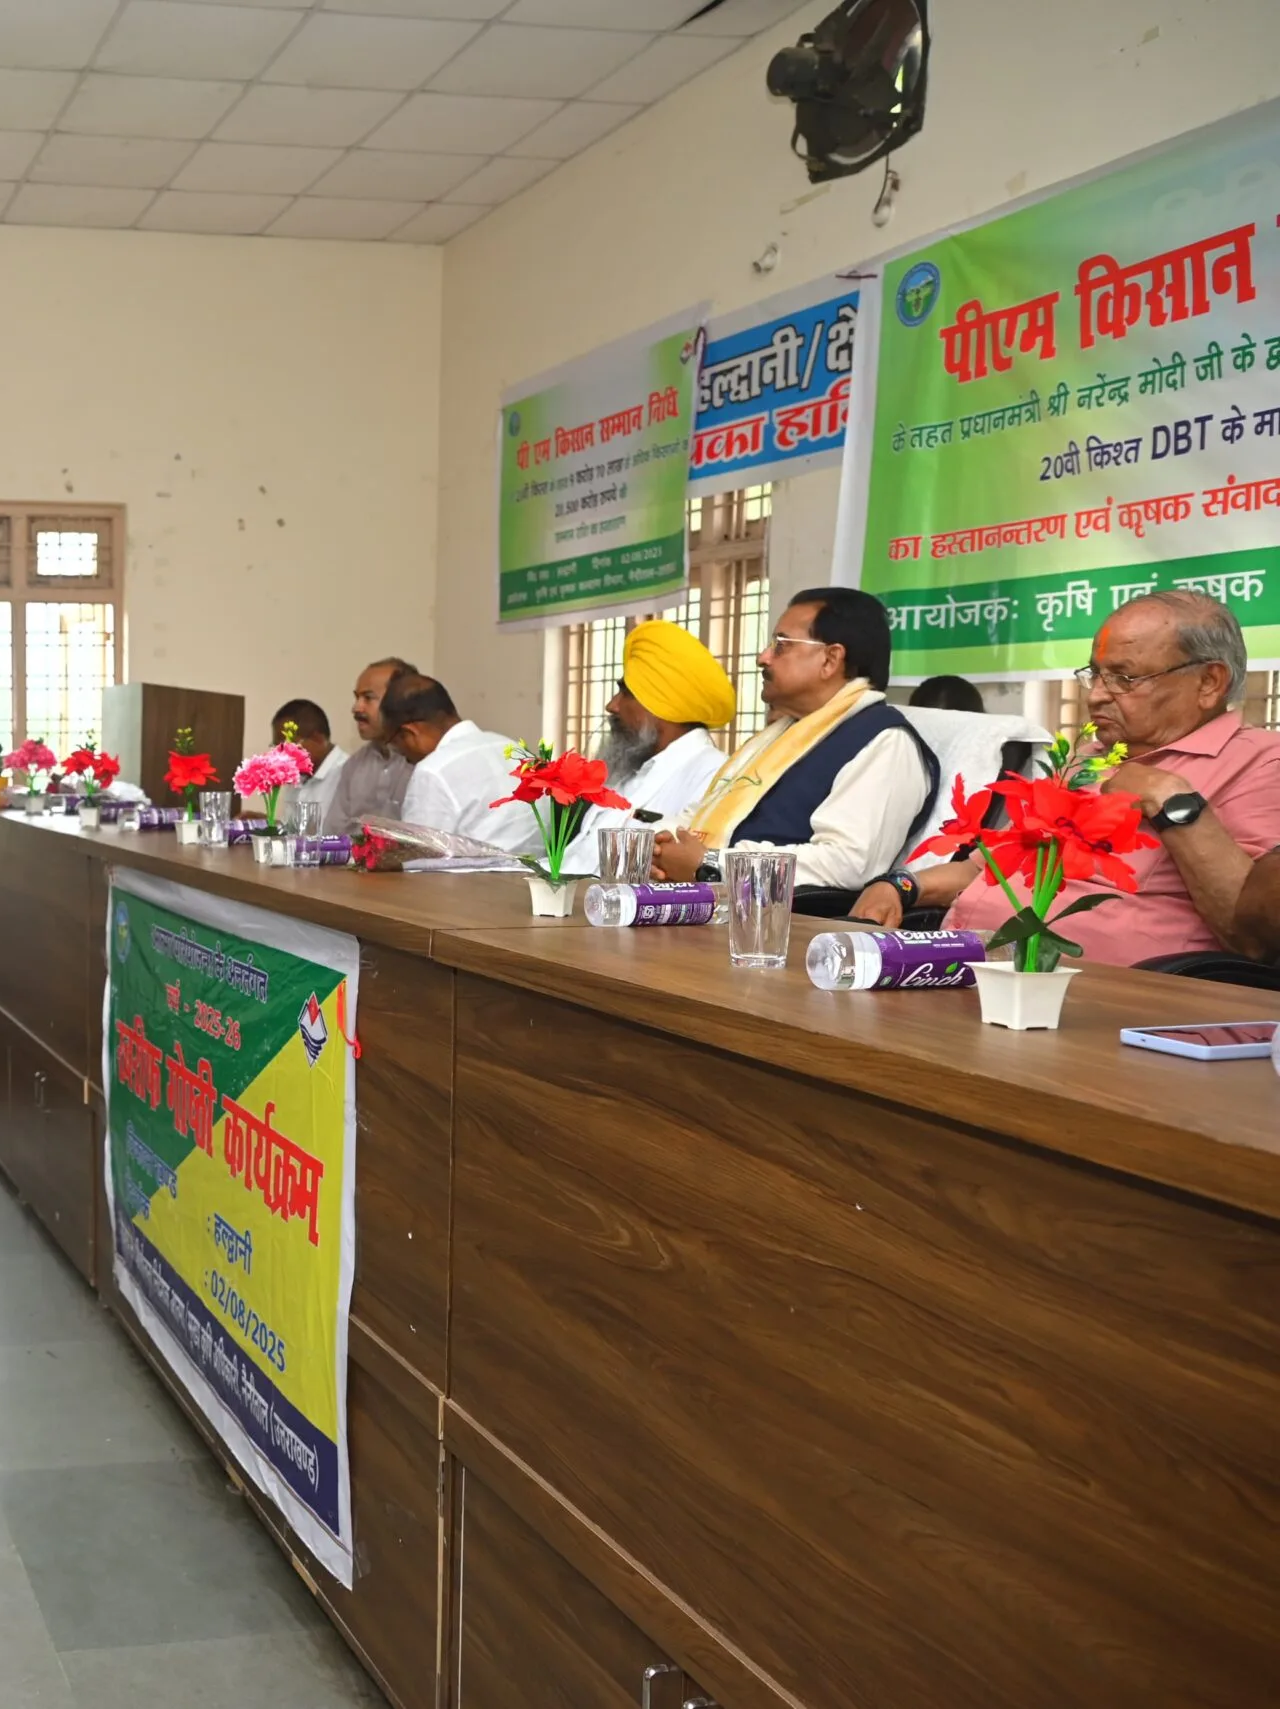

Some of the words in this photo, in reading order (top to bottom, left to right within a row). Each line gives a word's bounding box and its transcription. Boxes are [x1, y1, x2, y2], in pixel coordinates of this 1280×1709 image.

[940, 291, 1060, 383] पीएम
[1074, 222, 1256, 349] किसान
[533, 437, 551, 465] एम
[554, 420, 595, 461] किसान
[599, 404, 644, 443] सम्मान
[892, 422, 906, 453] के
[910, 421, 953, 450] तहत
[960, 390, 1041, 439] प्रधानमंत्री
[1047, 381, 1070, 417] श्री
[1137, 351, 1186, 395] मोदी
[1193, 341, 1224, 381] जी
[1231, 332, 1257, 373] के
[1086, 435, 1143, 472] किश्त
[1151, 414, 1214, 461] DBT
[1221, 404, 1246, 445] के
[888, 536, 923, 561] का
[1074, 496, 1113, 540] एवं
[1118, 492, 1195, 538] कृषक
[1202, 474, 1280, 517] संवाद
[1035, 580, 1098, 633] कृषि
[194, 999, 241, 1051] 2025-26
[165, 1040, 217, 1158] गोष्ठी
[221, 1093, 324, 1247] कार्यक्रम
[210, 1269, 287, 1373] 02/08/2025
